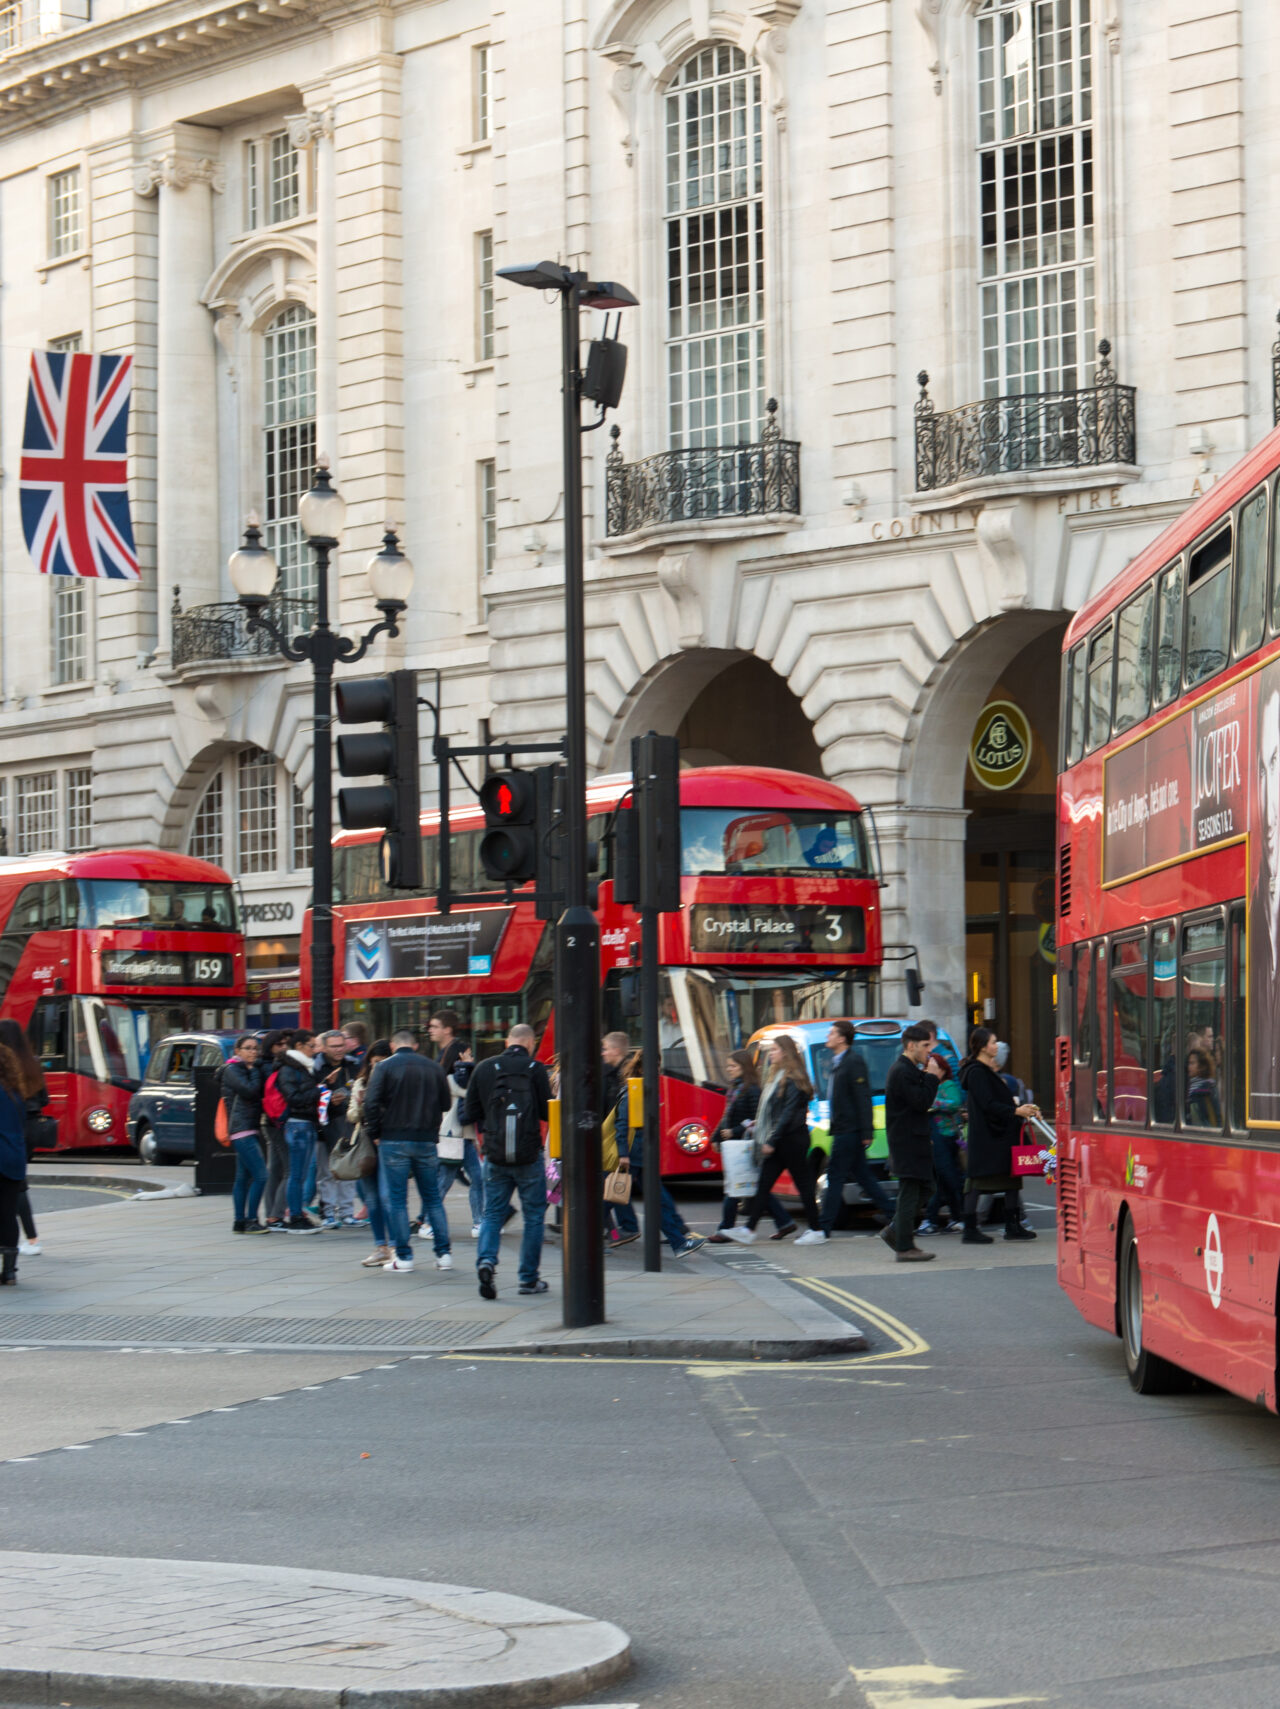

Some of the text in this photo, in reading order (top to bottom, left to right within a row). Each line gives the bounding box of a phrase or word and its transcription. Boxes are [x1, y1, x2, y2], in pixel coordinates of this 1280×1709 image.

[977, 744, 1022, 765] LOTUS
[1194, 720, 1241, 810] LUCIFER
[703, 918, 795, 936] Crystal Palace
[825, 915, 842, 941] 3
[195, 959, 222, 979] 159
